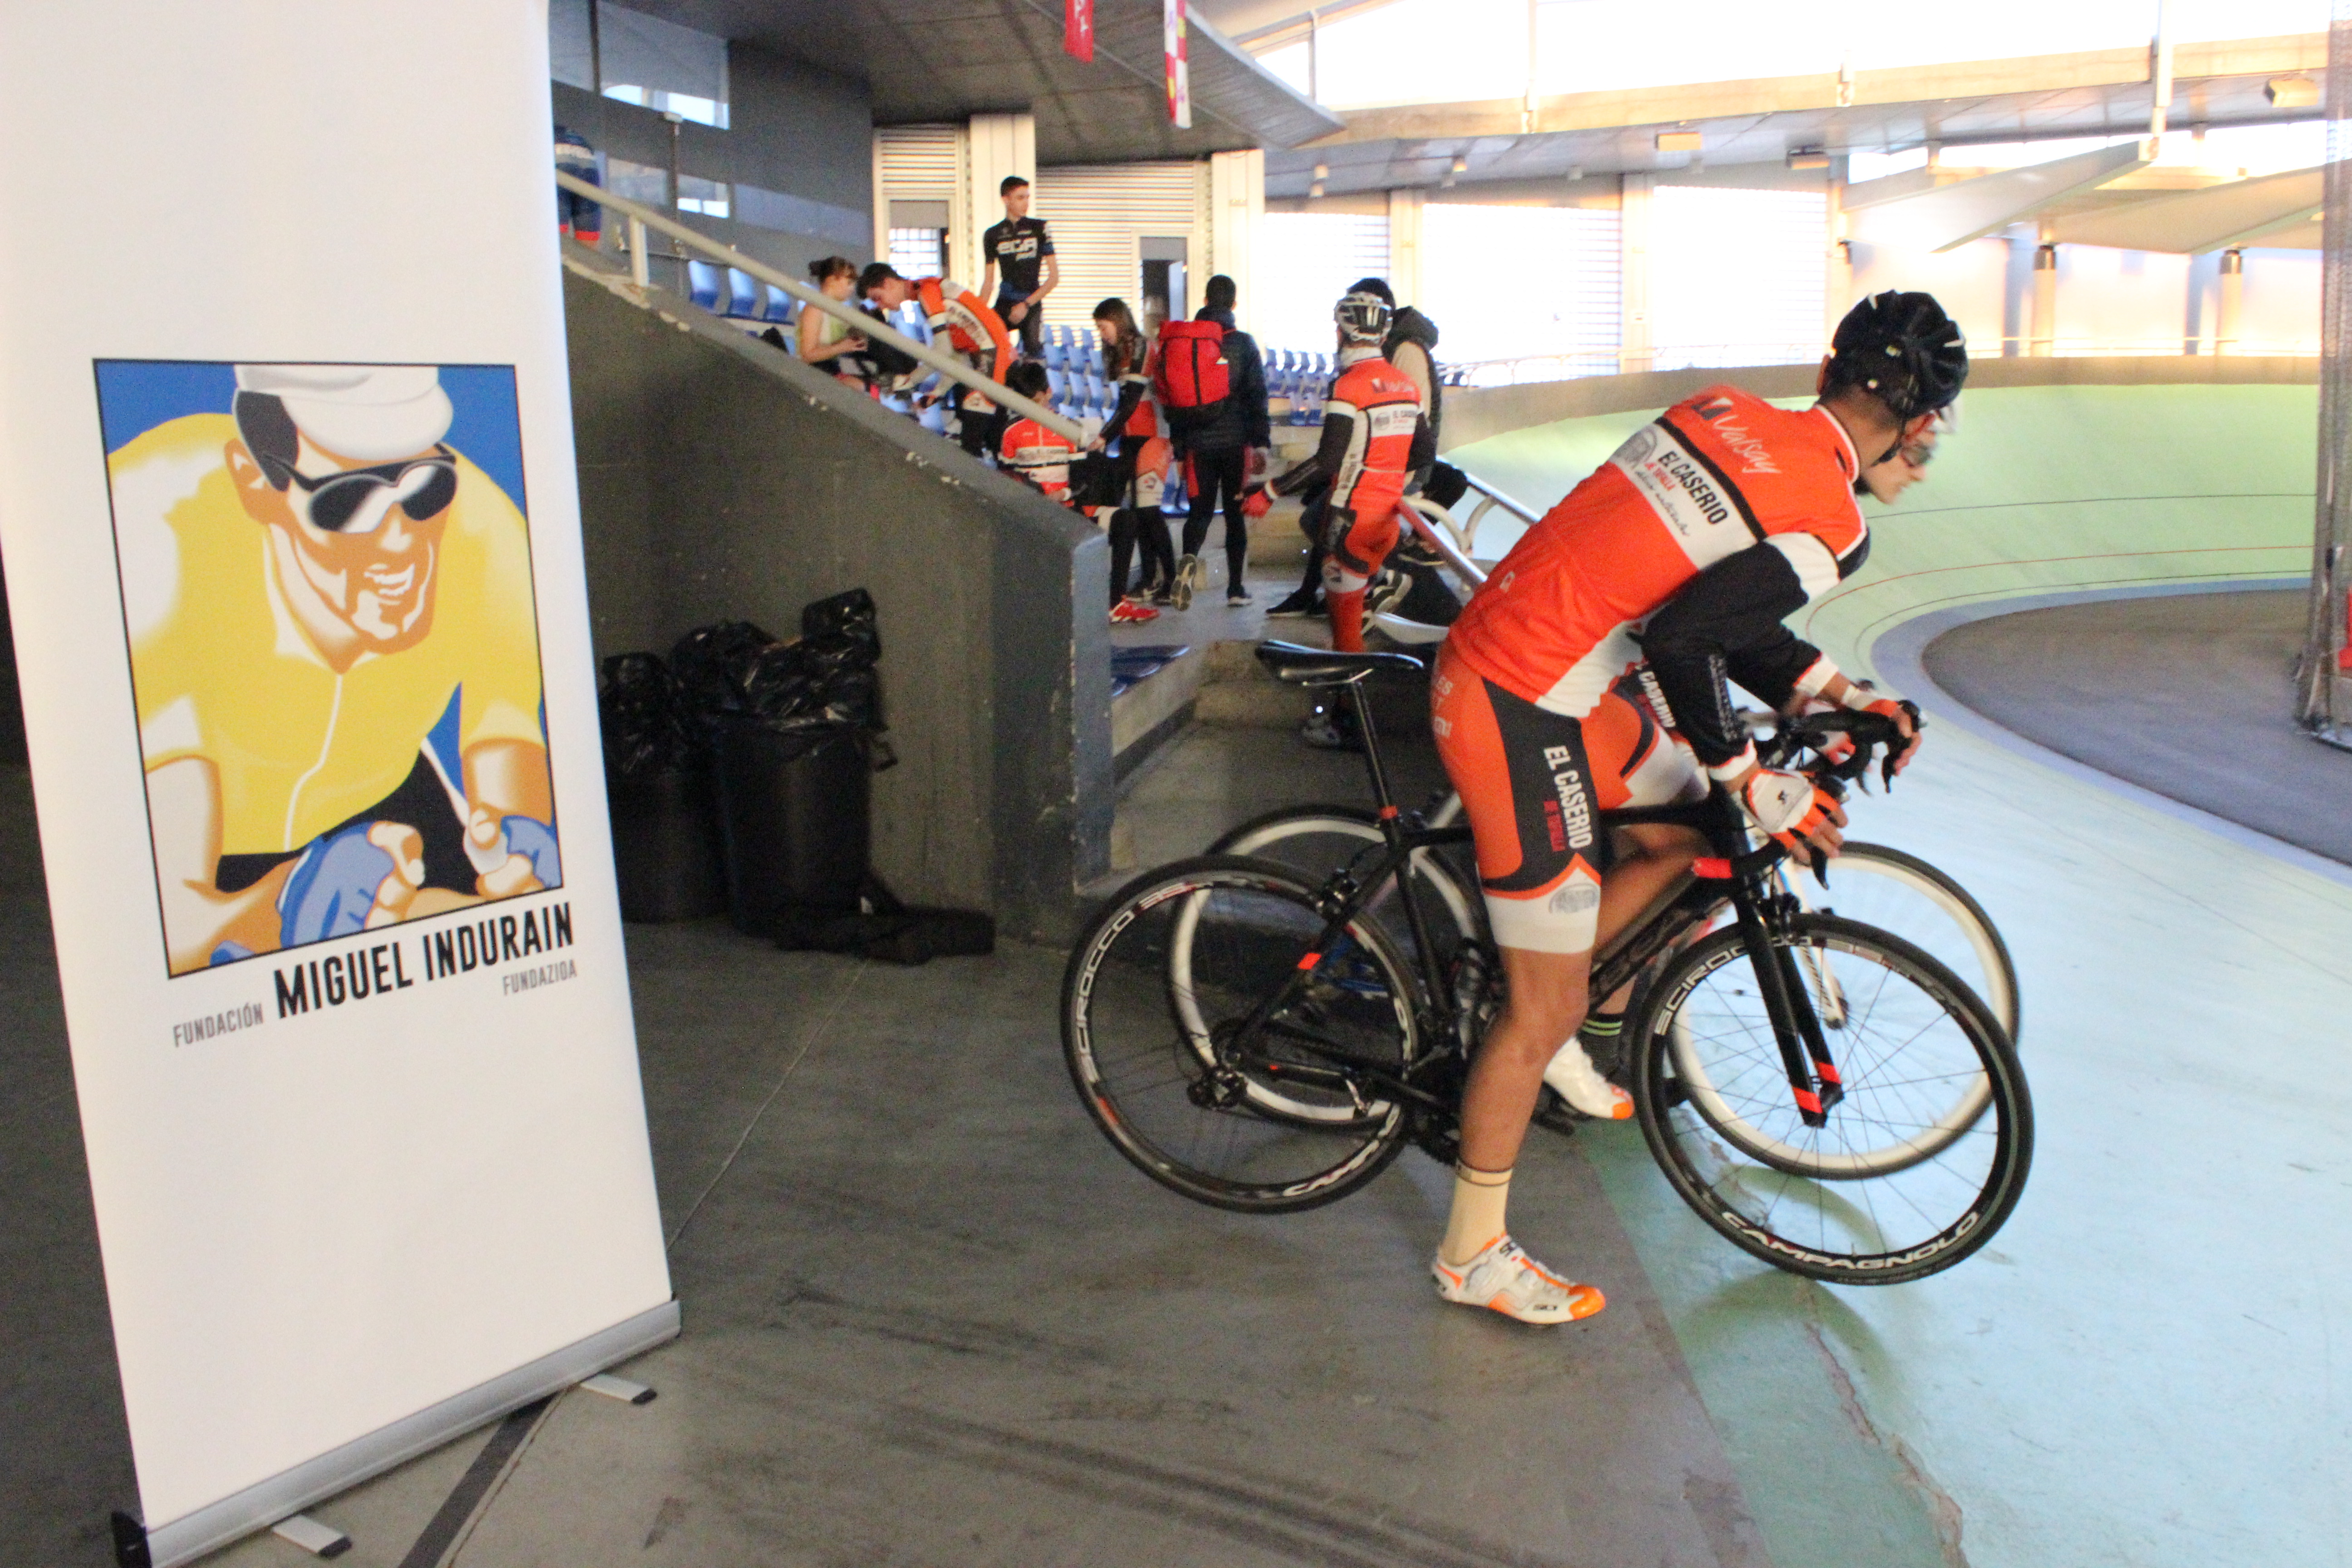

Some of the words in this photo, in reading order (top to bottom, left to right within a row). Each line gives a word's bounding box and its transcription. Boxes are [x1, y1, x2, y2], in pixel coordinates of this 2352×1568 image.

[1658, 450, 1681, 467] EL
[1670, 463, 1728, 524] CASERIO
[1544, 745, 1571, 770] EL
[1554, 770, 1593, 849] CASERIO
[172, 1001, 264, 1048] FUNDACIÓN
[274, 941, 413, 1019] MIGUEL
[422, 902, 573, 981] INDURAIN
[503, 959, 578, 996] FUNDAZIOA
[1722, 1211, 1979, 1270] CAMPAGNOLO
